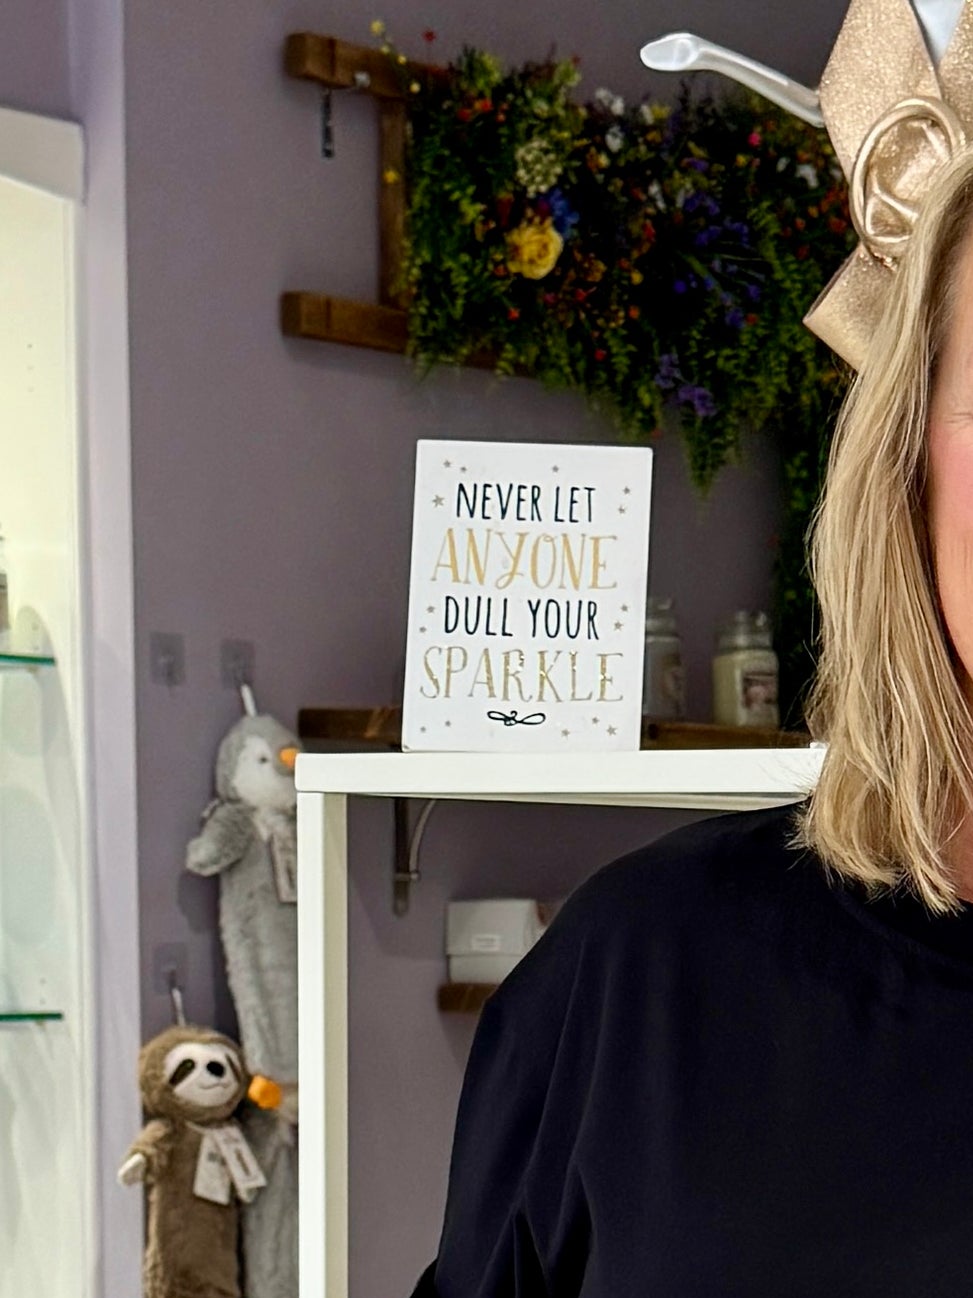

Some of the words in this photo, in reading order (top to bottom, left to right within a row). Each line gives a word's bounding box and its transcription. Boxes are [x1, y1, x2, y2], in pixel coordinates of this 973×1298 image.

[456, 483, 542, 522] NEVER
[554, 486, 596, 523] LET
[430, 528, 618, 591] ANYONE
[444, 596, 513, 637] DULL
[527, 599, 600, 640] YOUR
[419, 646, 624, 703] SPARKLE
